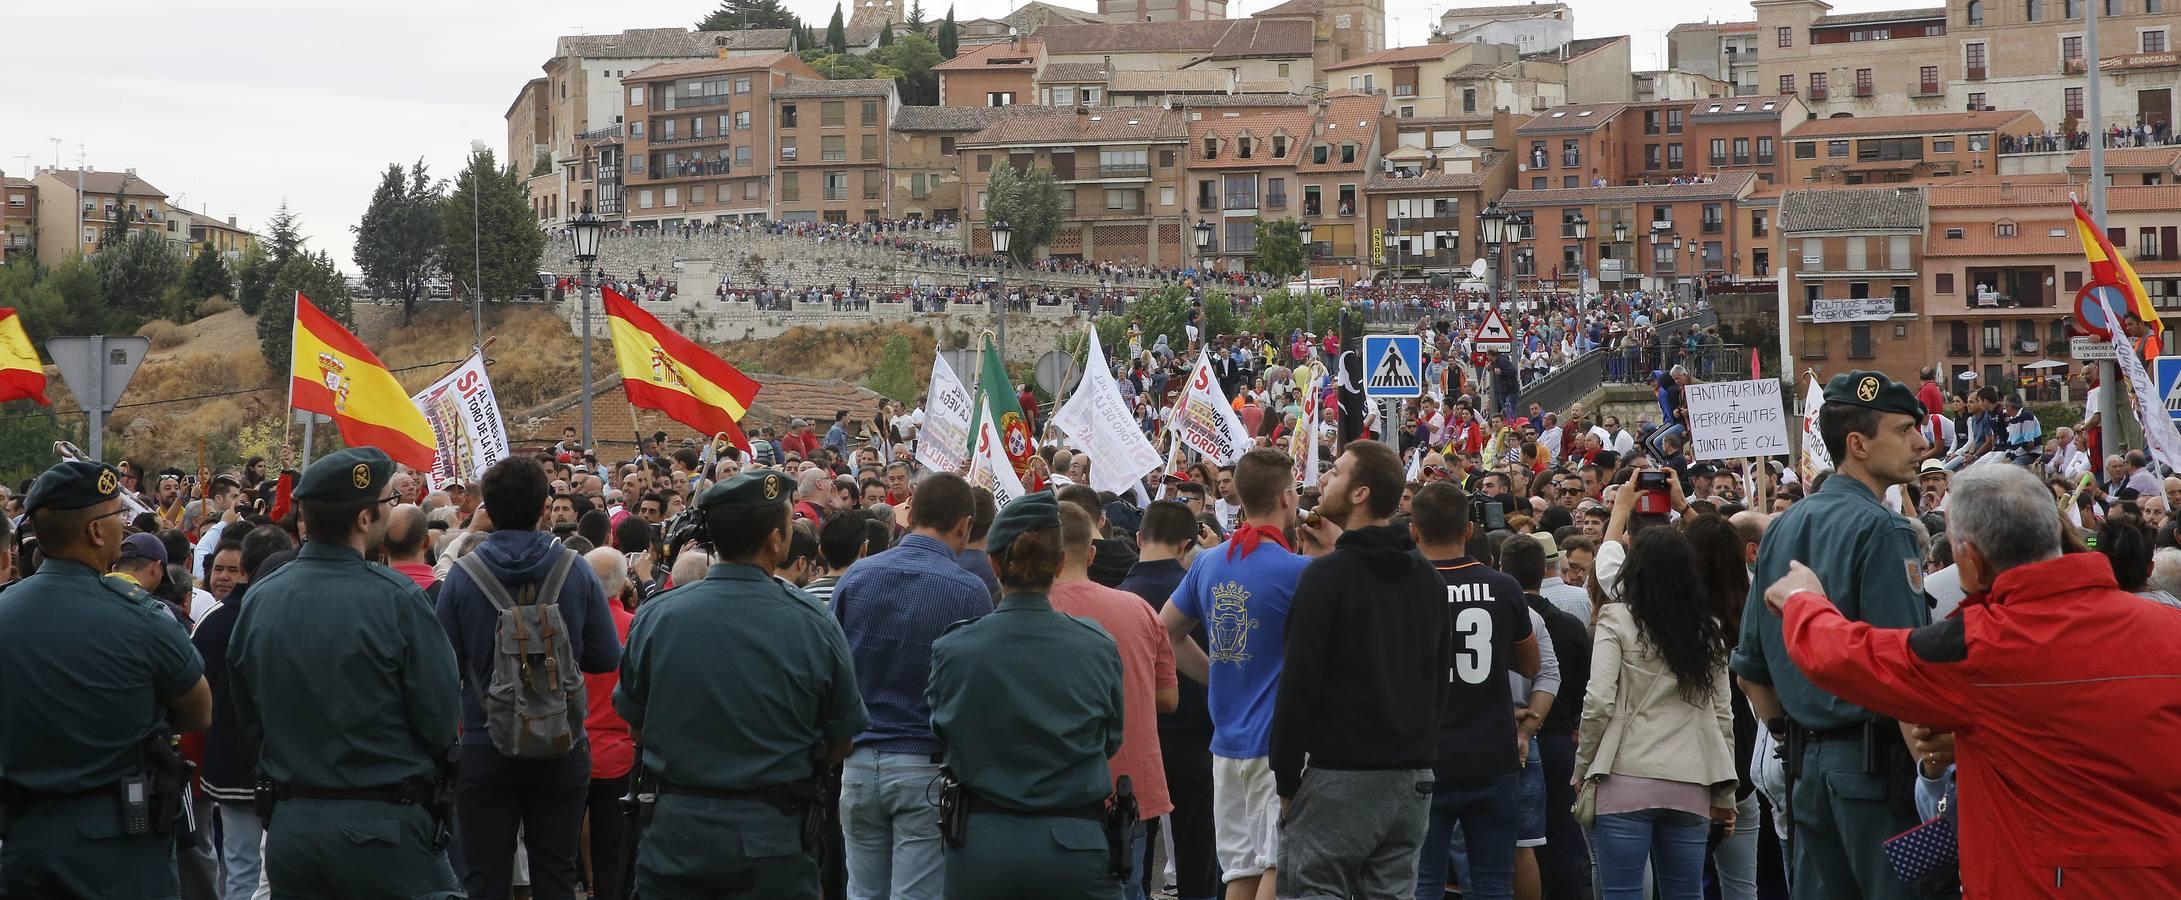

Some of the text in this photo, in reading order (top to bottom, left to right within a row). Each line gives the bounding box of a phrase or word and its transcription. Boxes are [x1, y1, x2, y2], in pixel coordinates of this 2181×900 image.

[1814, 309, 1862, 320] CABRONES
[477, 389, 487, 403] AL
[1690, 380, 1779, 401] ANTITAURINOS
[1692, 407, 1778, 429] PERROFLAUTAS
[467, 396, 497, 467] TORO DE LA VEG
[1696, 435, 1783, 454] JUNTA DE CYL
[1446, 583, 1496, 602] MIL
